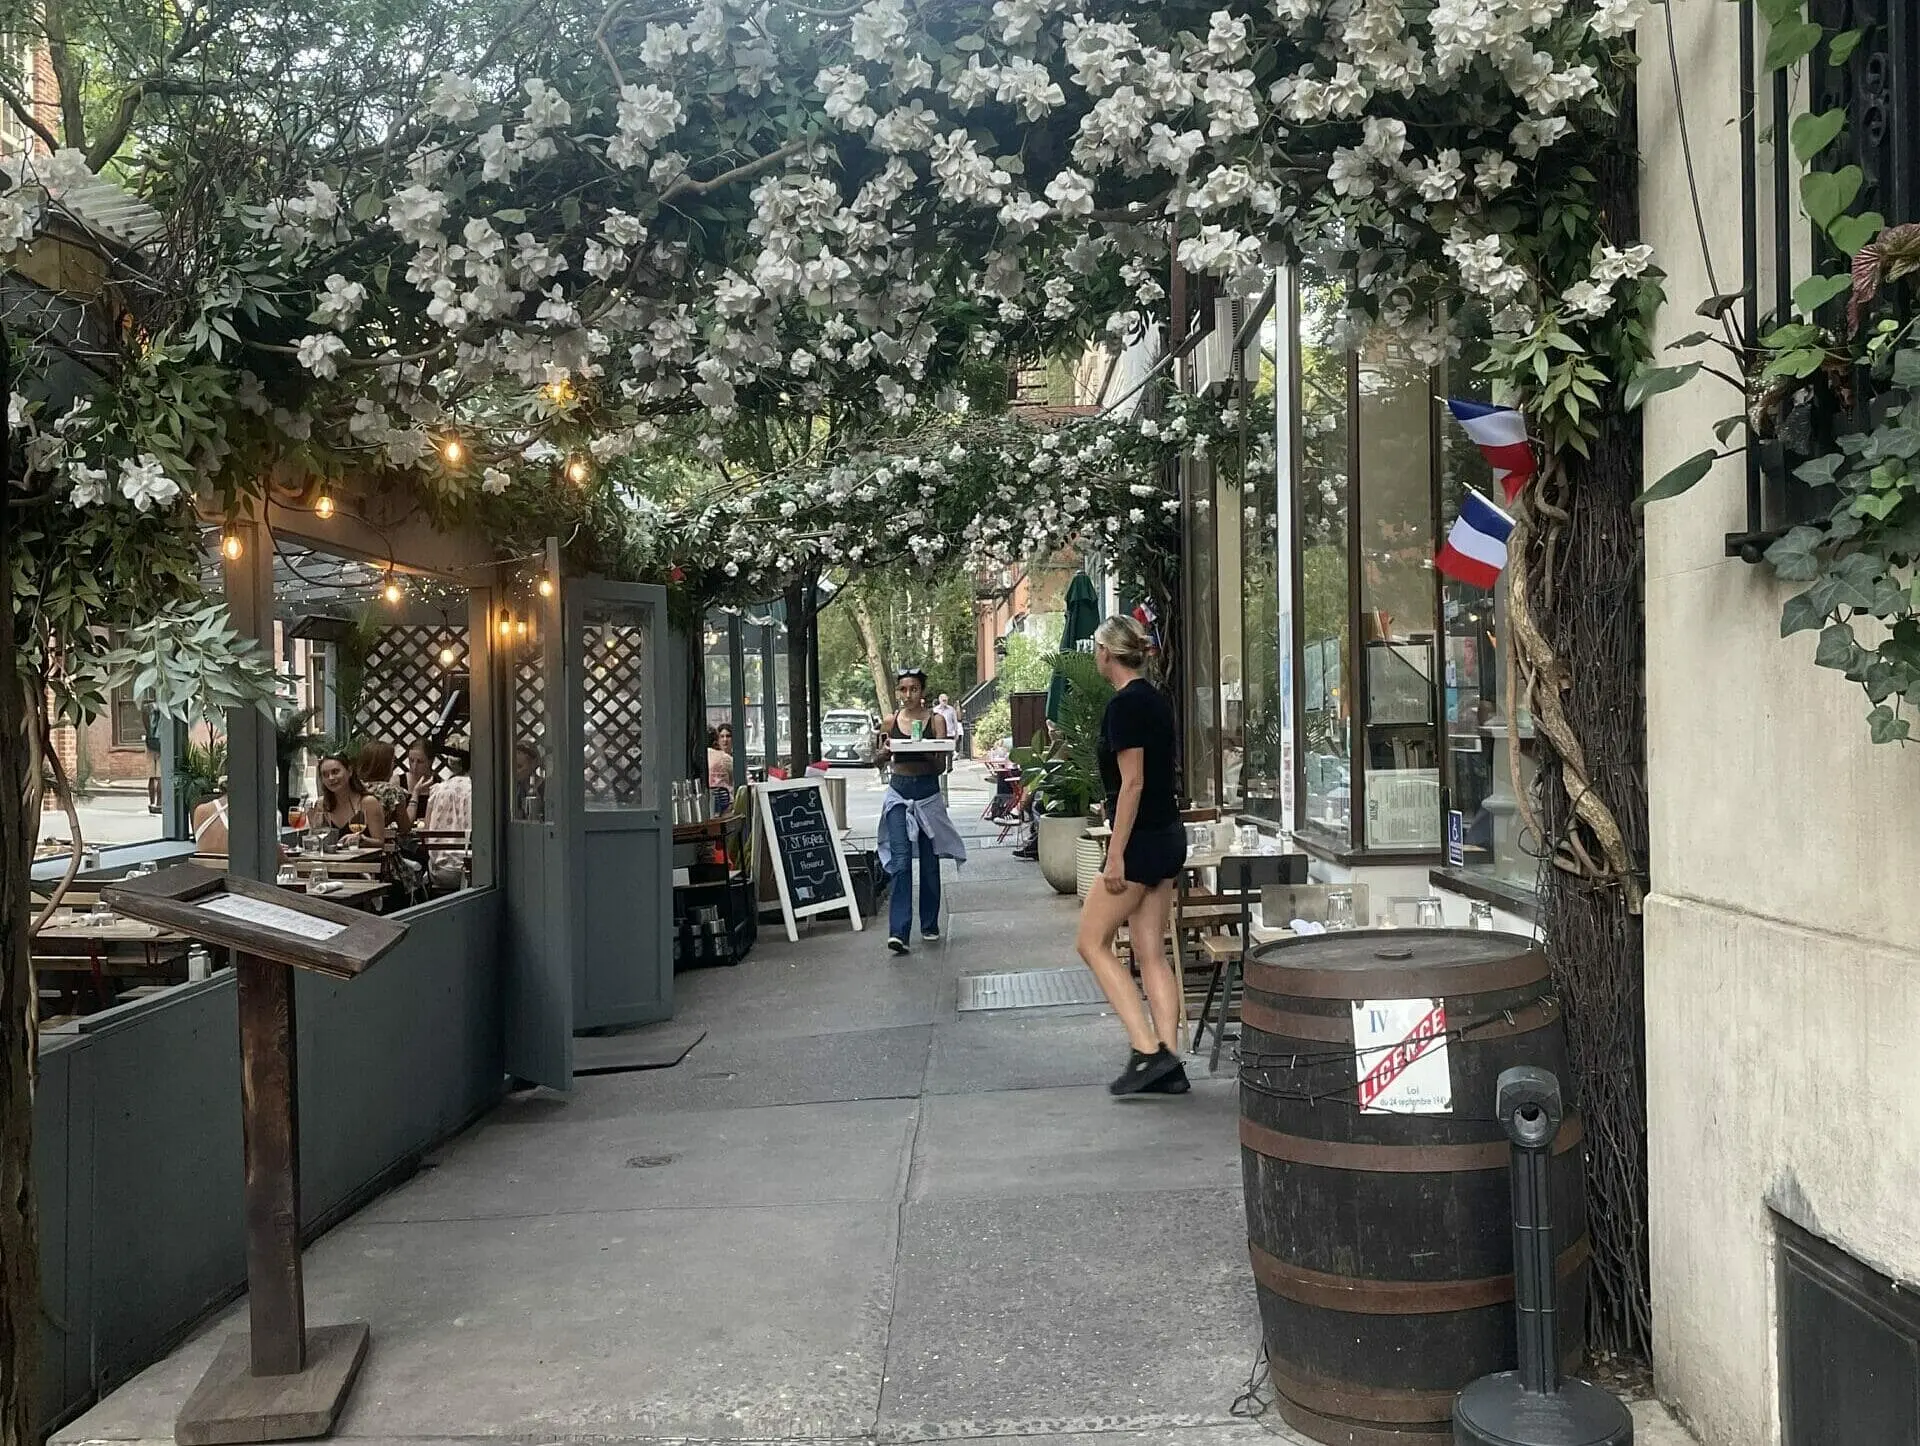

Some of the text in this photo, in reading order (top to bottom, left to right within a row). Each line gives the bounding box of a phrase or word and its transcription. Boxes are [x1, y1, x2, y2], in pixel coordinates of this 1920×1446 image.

[1370, 1010, 1388, 1032] IV
[1360, 1007, 1446, 1102] LICENCE
[1407, 1086, 1419, 1095] Loi
